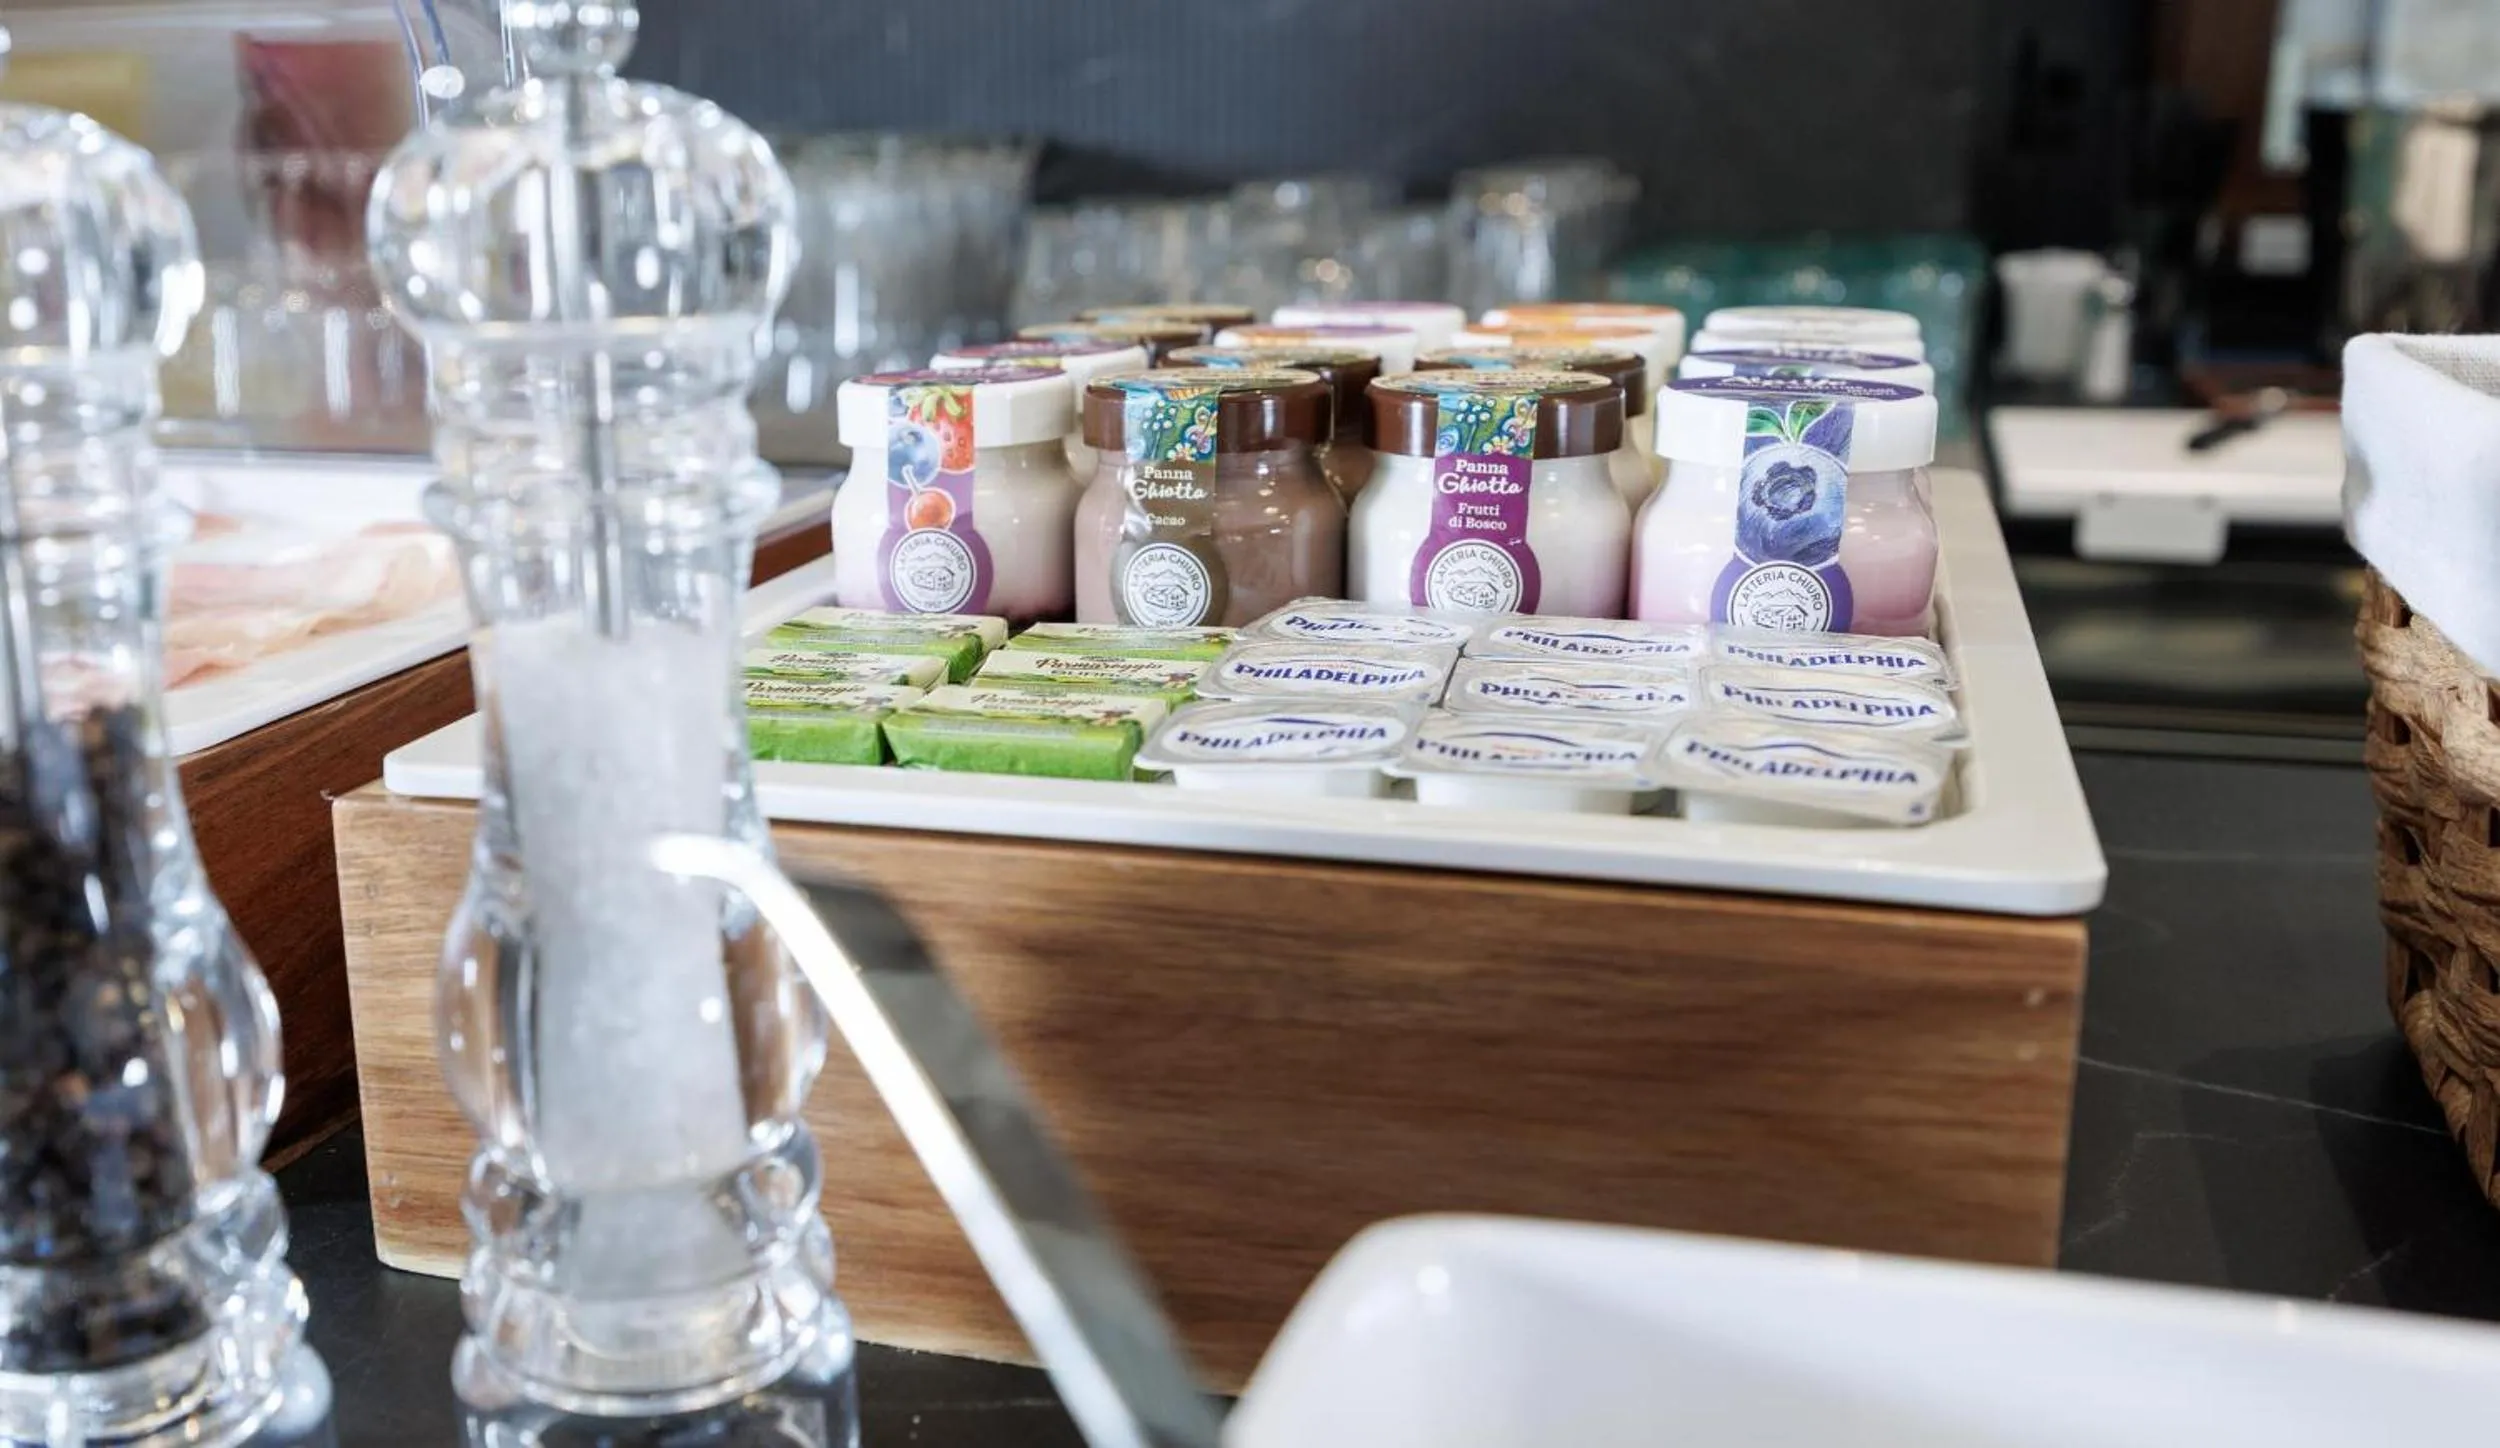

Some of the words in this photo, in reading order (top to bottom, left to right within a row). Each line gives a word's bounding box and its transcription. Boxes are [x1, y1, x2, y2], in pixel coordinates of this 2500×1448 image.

[1144, 466, 1193, 480] Panna
[1455, 459, 1509, 474] Panna
[1132, 480, 1209, 499] Ghiotta
[1438, 472, 1523, 494] Ghiotta
[1457, 502, 1500, 516] Frutti
[1147, 513, 1186, 526] Cacao
[1448, 516, 1463, 528] di
[1466, 517, 1507, 531] Bosco
[1168, 553, 1203, 592] CHIURO
[1434, 549, 1477, 584] LATTERIA
[1480, 551, 1514, 590] CHIURO
[1739, 570, 1785, 607] LATTERIA
[1788, 572, 1823, 611] CHIURO
[1234, 662, 1426, 685] PHILADELPHIA
[1177, 726, 1387, 750] PHILADELPHIA
